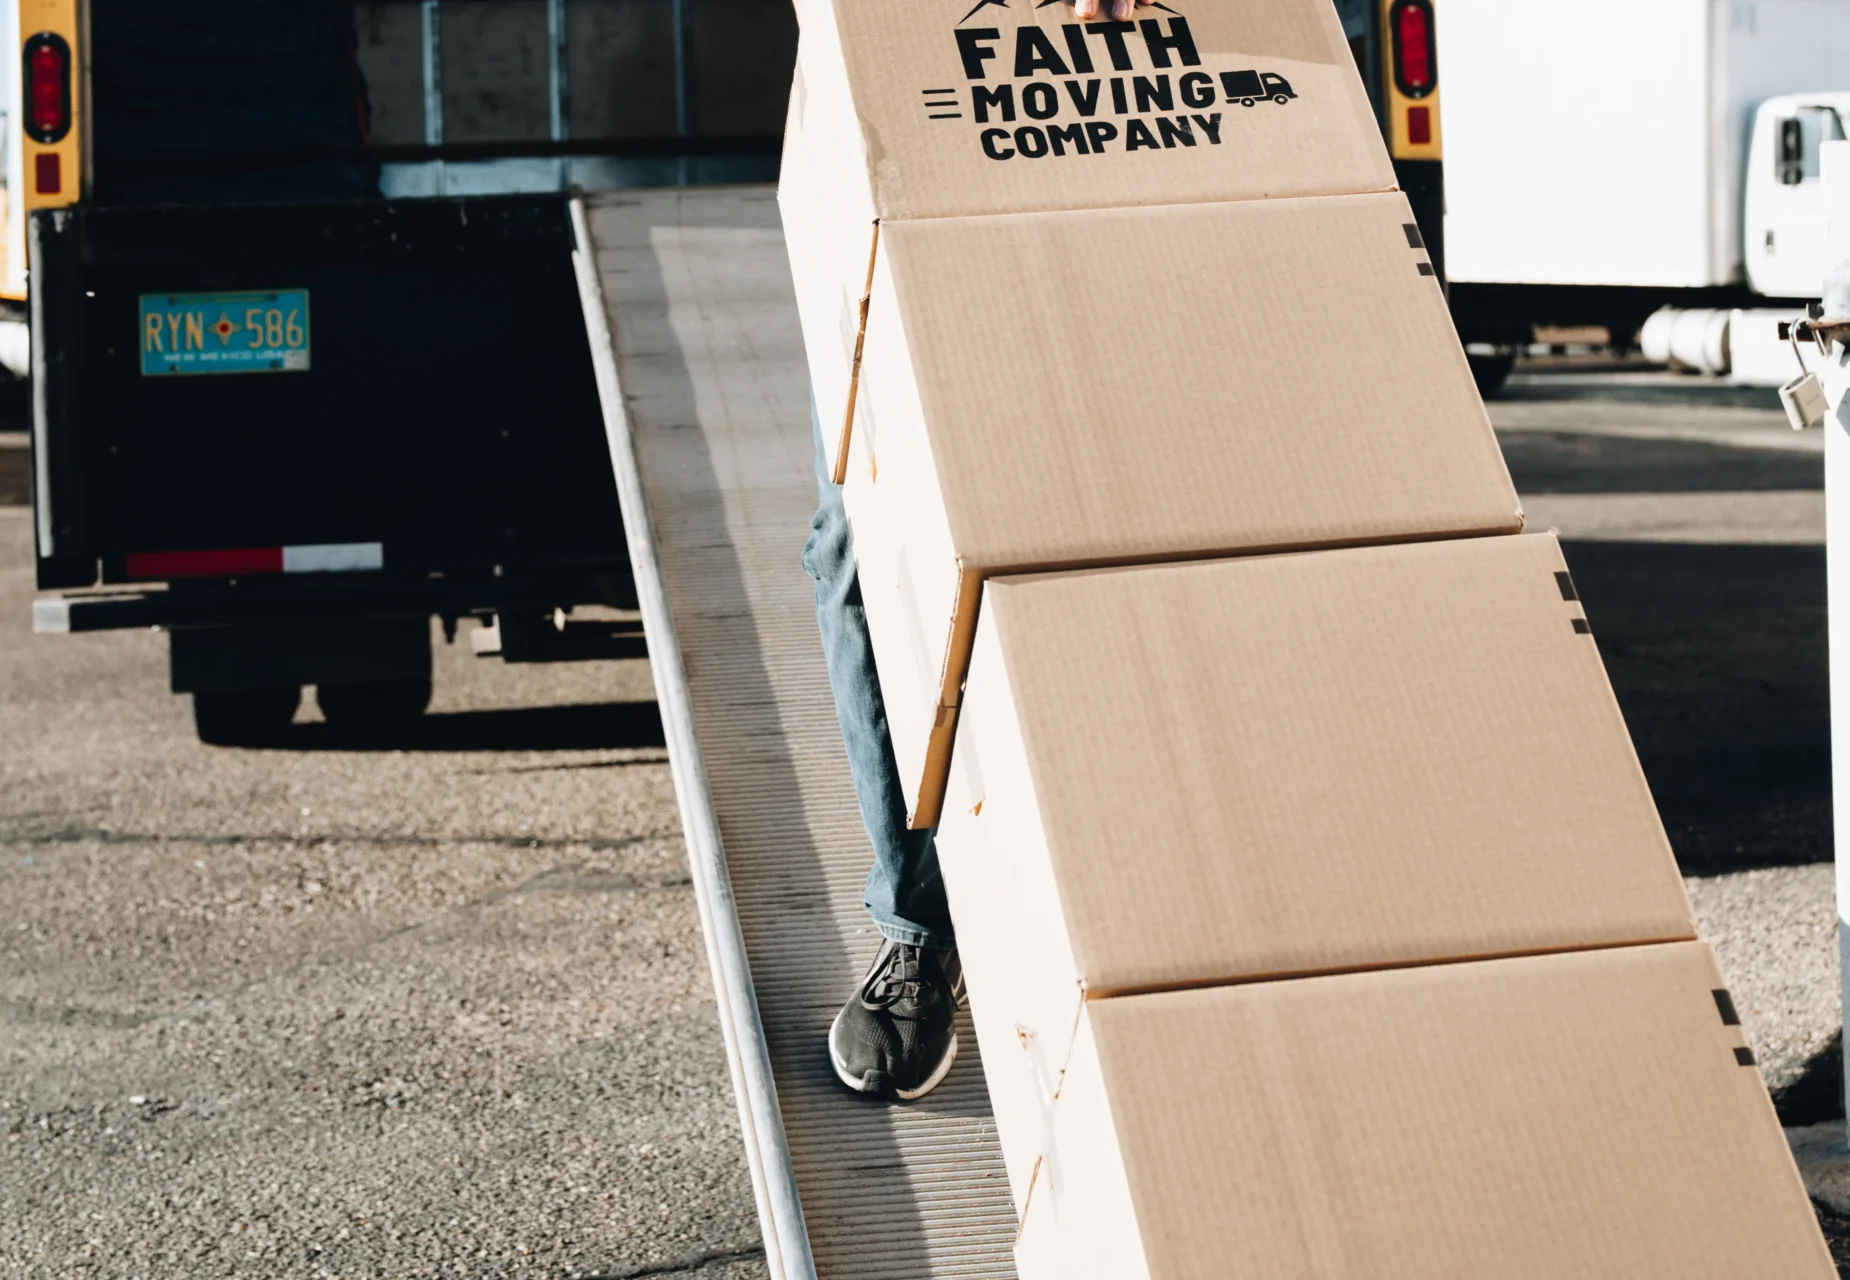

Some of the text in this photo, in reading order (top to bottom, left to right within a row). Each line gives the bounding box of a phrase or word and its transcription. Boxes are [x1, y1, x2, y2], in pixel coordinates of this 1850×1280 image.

[953, 16, 1201, 80] FAITH
[971, 71, 1216, 123] MOVING
[980, 112, 1222, 161] COMPANY
[145, 308, 303, 353] RYN 586
